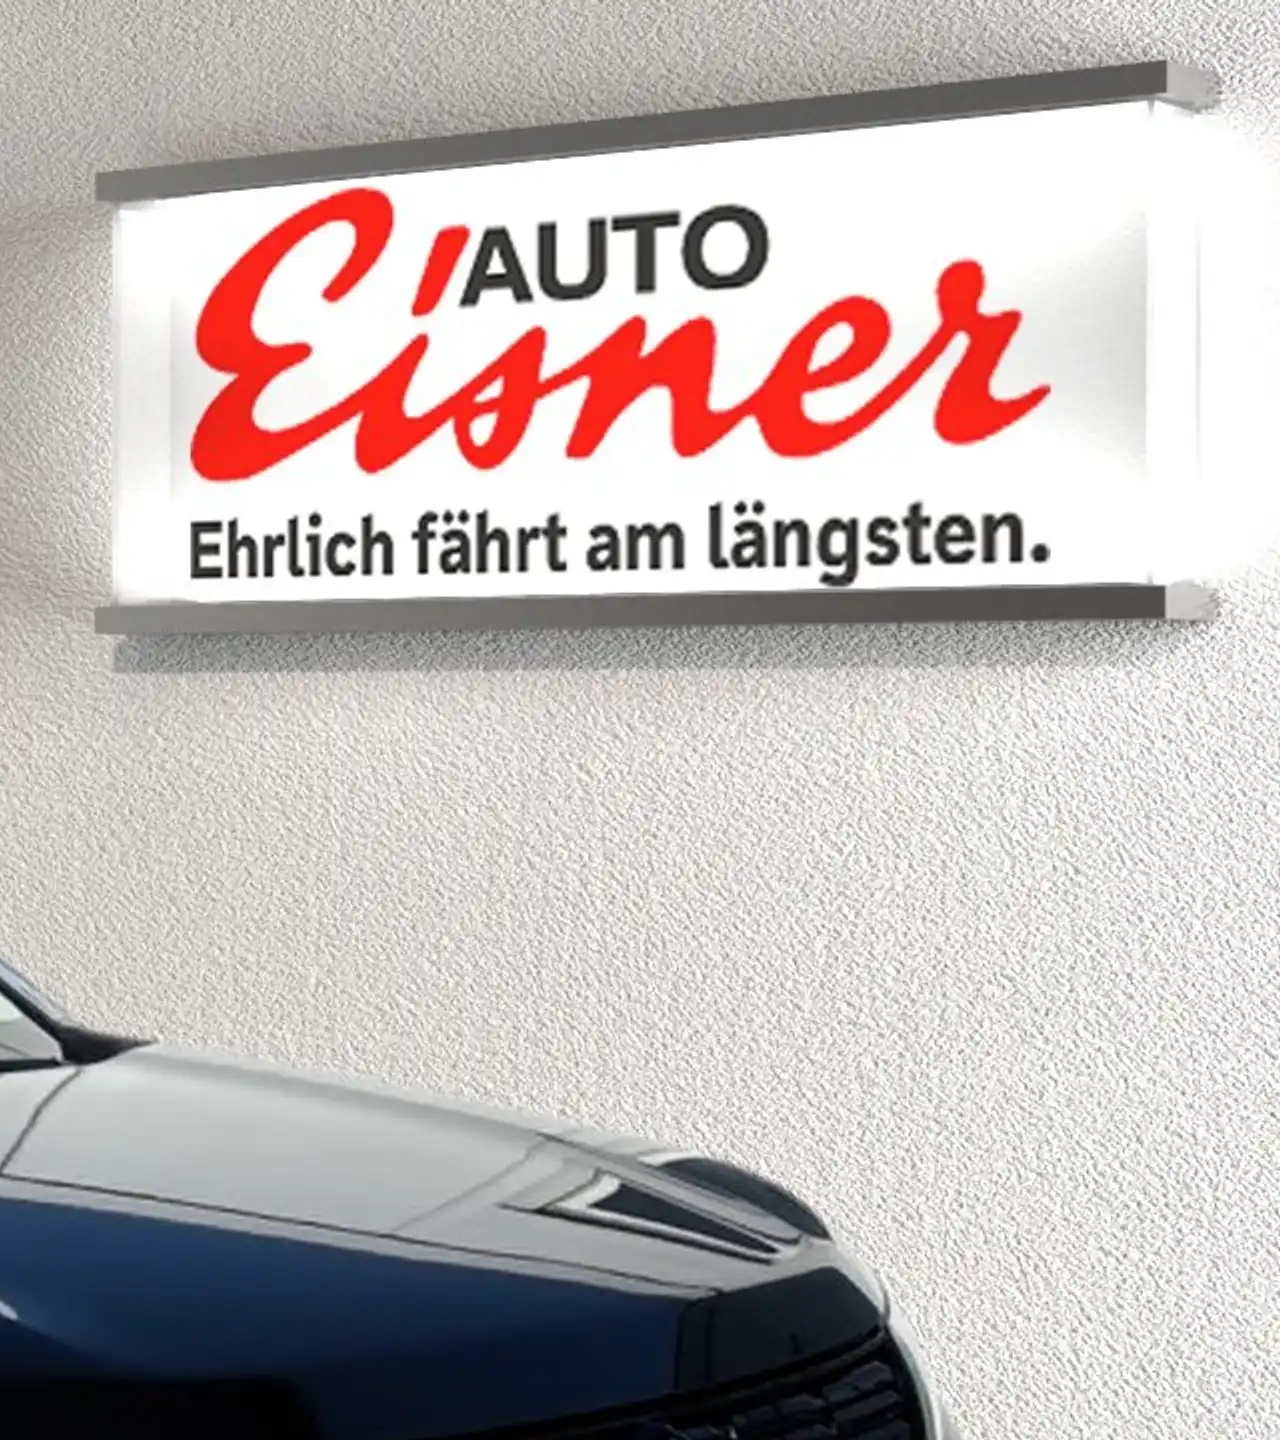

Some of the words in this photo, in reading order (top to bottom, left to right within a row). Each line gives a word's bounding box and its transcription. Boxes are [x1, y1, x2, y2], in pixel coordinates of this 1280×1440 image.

[460, 205, 769, 307] AUTO
[191, 187, 1051, 483] Eisner
[190, 512, 394, 579] Ehrlich
[411, 510, 567, 575] fährt
[586, 522, 685, 572] am
[709, 500, 1050, 587] längsten.
